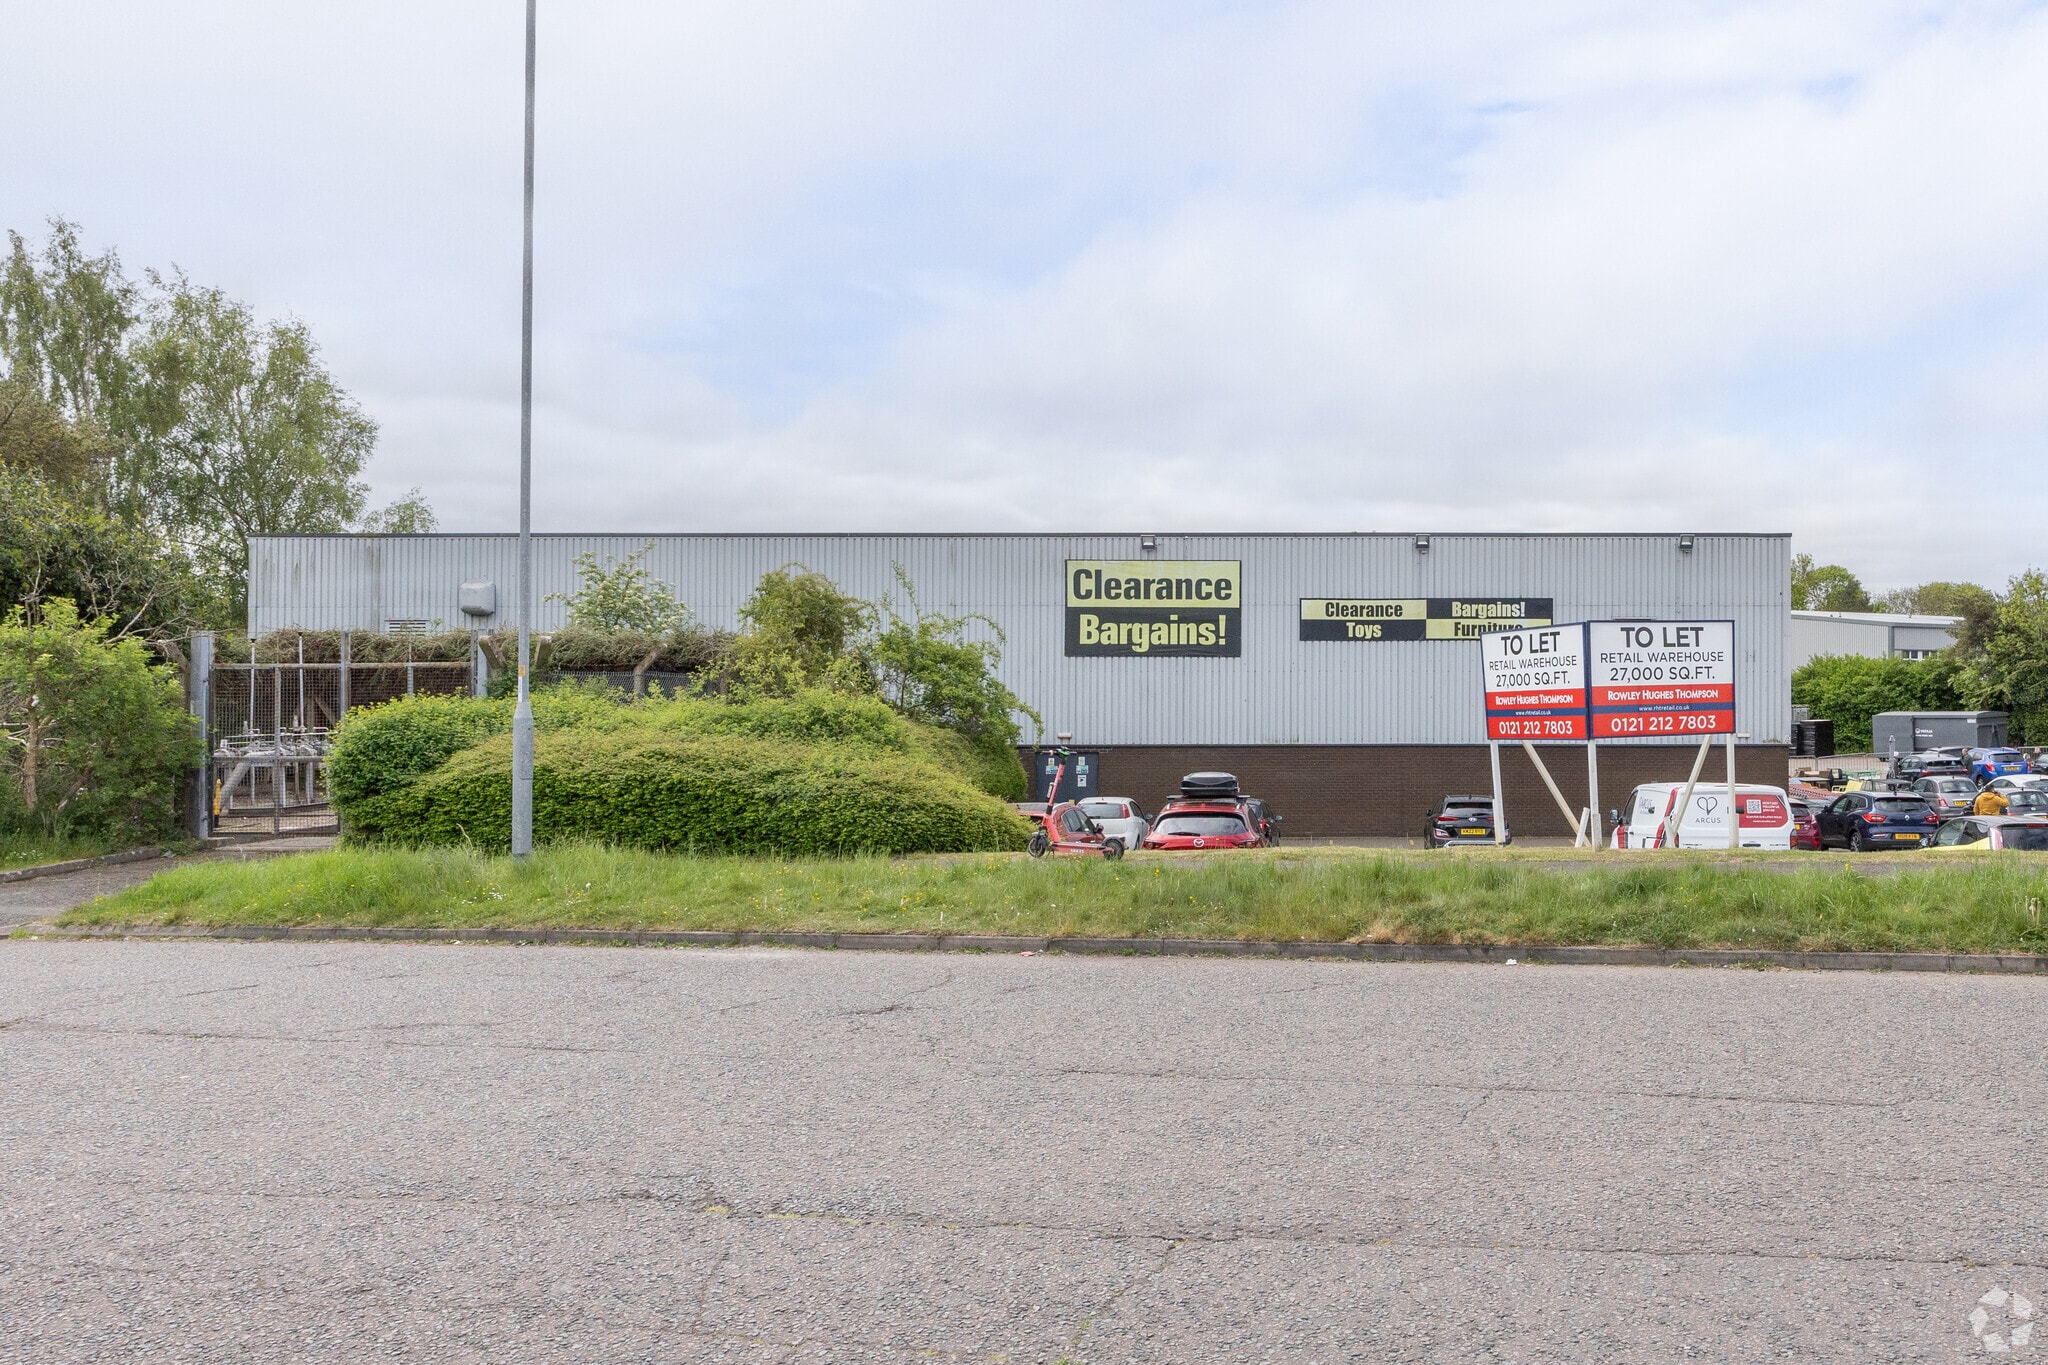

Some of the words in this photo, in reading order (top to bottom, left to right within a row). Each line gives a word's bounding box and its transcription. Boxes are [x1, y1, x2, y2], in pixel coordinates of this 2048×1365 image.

[1073, 568, 1232, 601] Clearance
[1325, 602, 1403, 618] Clearance
[1452, 601, 1526, 619] Bargains!
[1079, 614, 1227, 653] Bargains!
[1346, 622, 1382, 639] Toys
[1620, 626, 1654, 648] TO
[1662, 626, 1704, 648] LET
[1501, 634, 1523, 656] TO
[1529, 631, 1560, 654] LET
[1489, 660, 1516, 671] RETAIL
[1518, 655, 1577, 669] WAREHOUSE
[1600, 652, 1643, 663] RETAIL
[1648, 651, 1724, 662] WAREHOUSE
[1496, 673, 1530, 689] 27,000
[1534, 671, 1570, 685] SQ.FT.
[1610, 667, 1663, 683] 27,000
[1669, 666, 1715, 680] SQ.FT.
[1495, 696, 1517, 706] ROWLEY
[1517, 695, 1539, 705] HUGHES
[1539, 694, 1573, 704] THOMPSON
[1607, 690, 1641, 701] ROWLEY
[1642, 689, 1674, 700] HUGHES
[1675, 688, 1719, 699] THOMPSON
[1499, 721, 1520, 735] 0121
[1523, 721, 1541, 735] 212
[1544, 720, 1573, 734] 7803
[1611, 717, 1643, 732] 0121
[1649, 716, 1673, 730] 212
[1679, 715, 1716, 729] 7803
